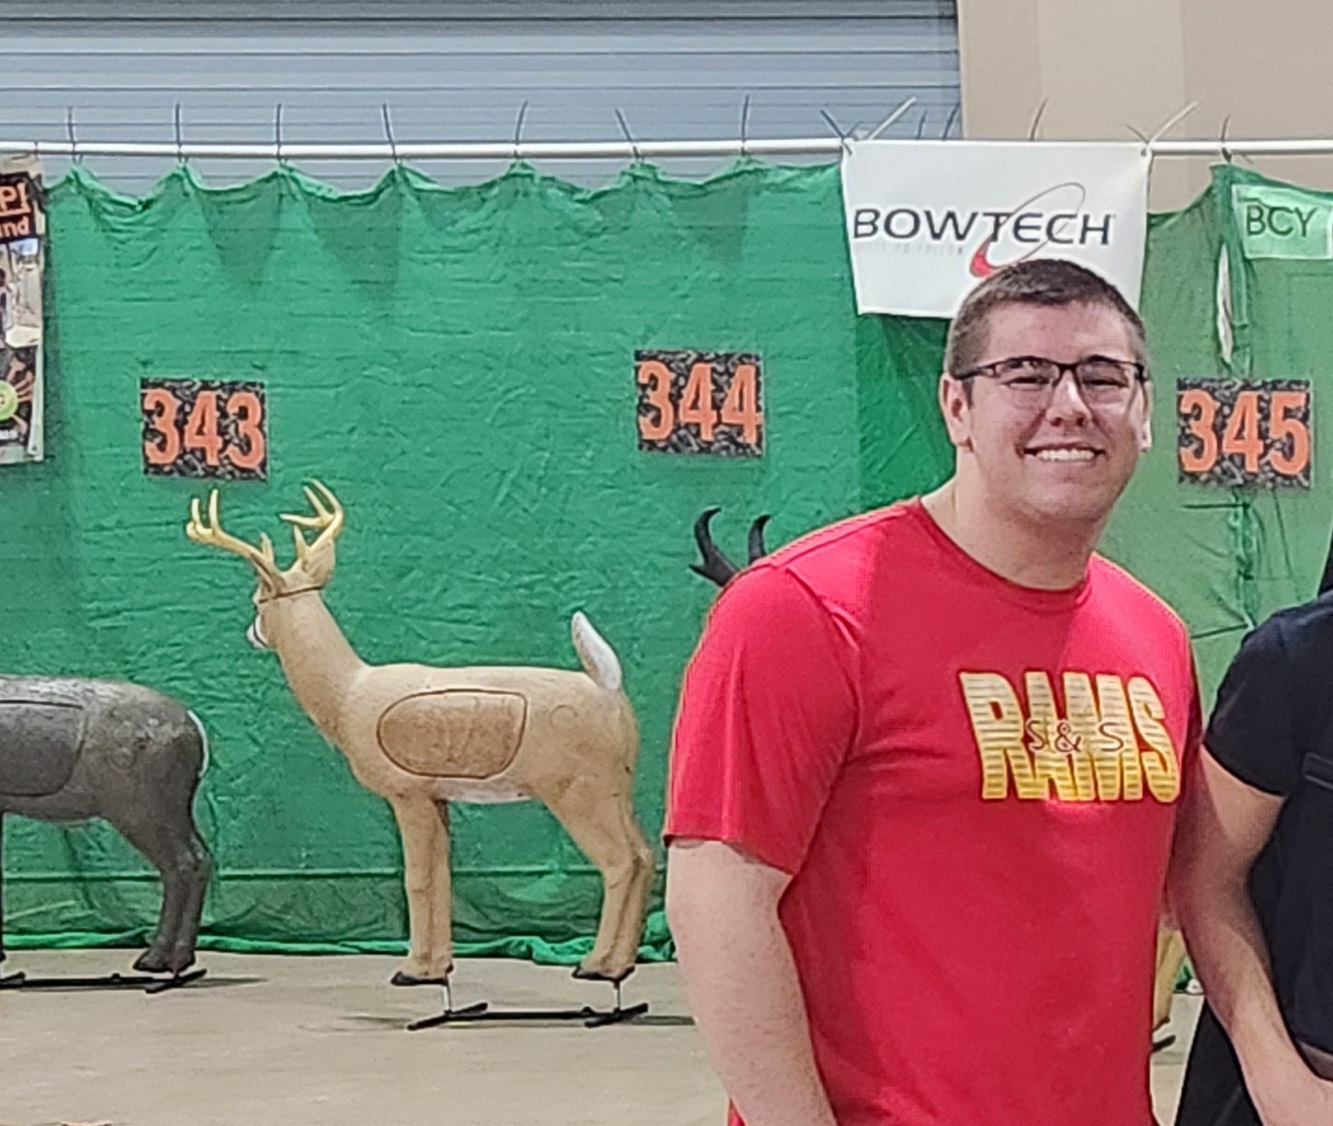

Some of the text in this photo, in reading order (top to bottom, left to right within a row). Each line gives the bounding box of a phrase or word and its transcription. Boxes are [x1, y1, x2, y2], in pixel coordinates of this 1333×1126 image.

[853, 206, 1112, 246] BOWTECH
[1246, 204, 1319, 238] BCY
[143, 387, 265, 470] 343
[637, 359, 762, 445] 344
[1179, 387, 1310, 476] 345
[958, 670, 1181, 804] RAMS
[1025, 719, 1125, 753] S & S
